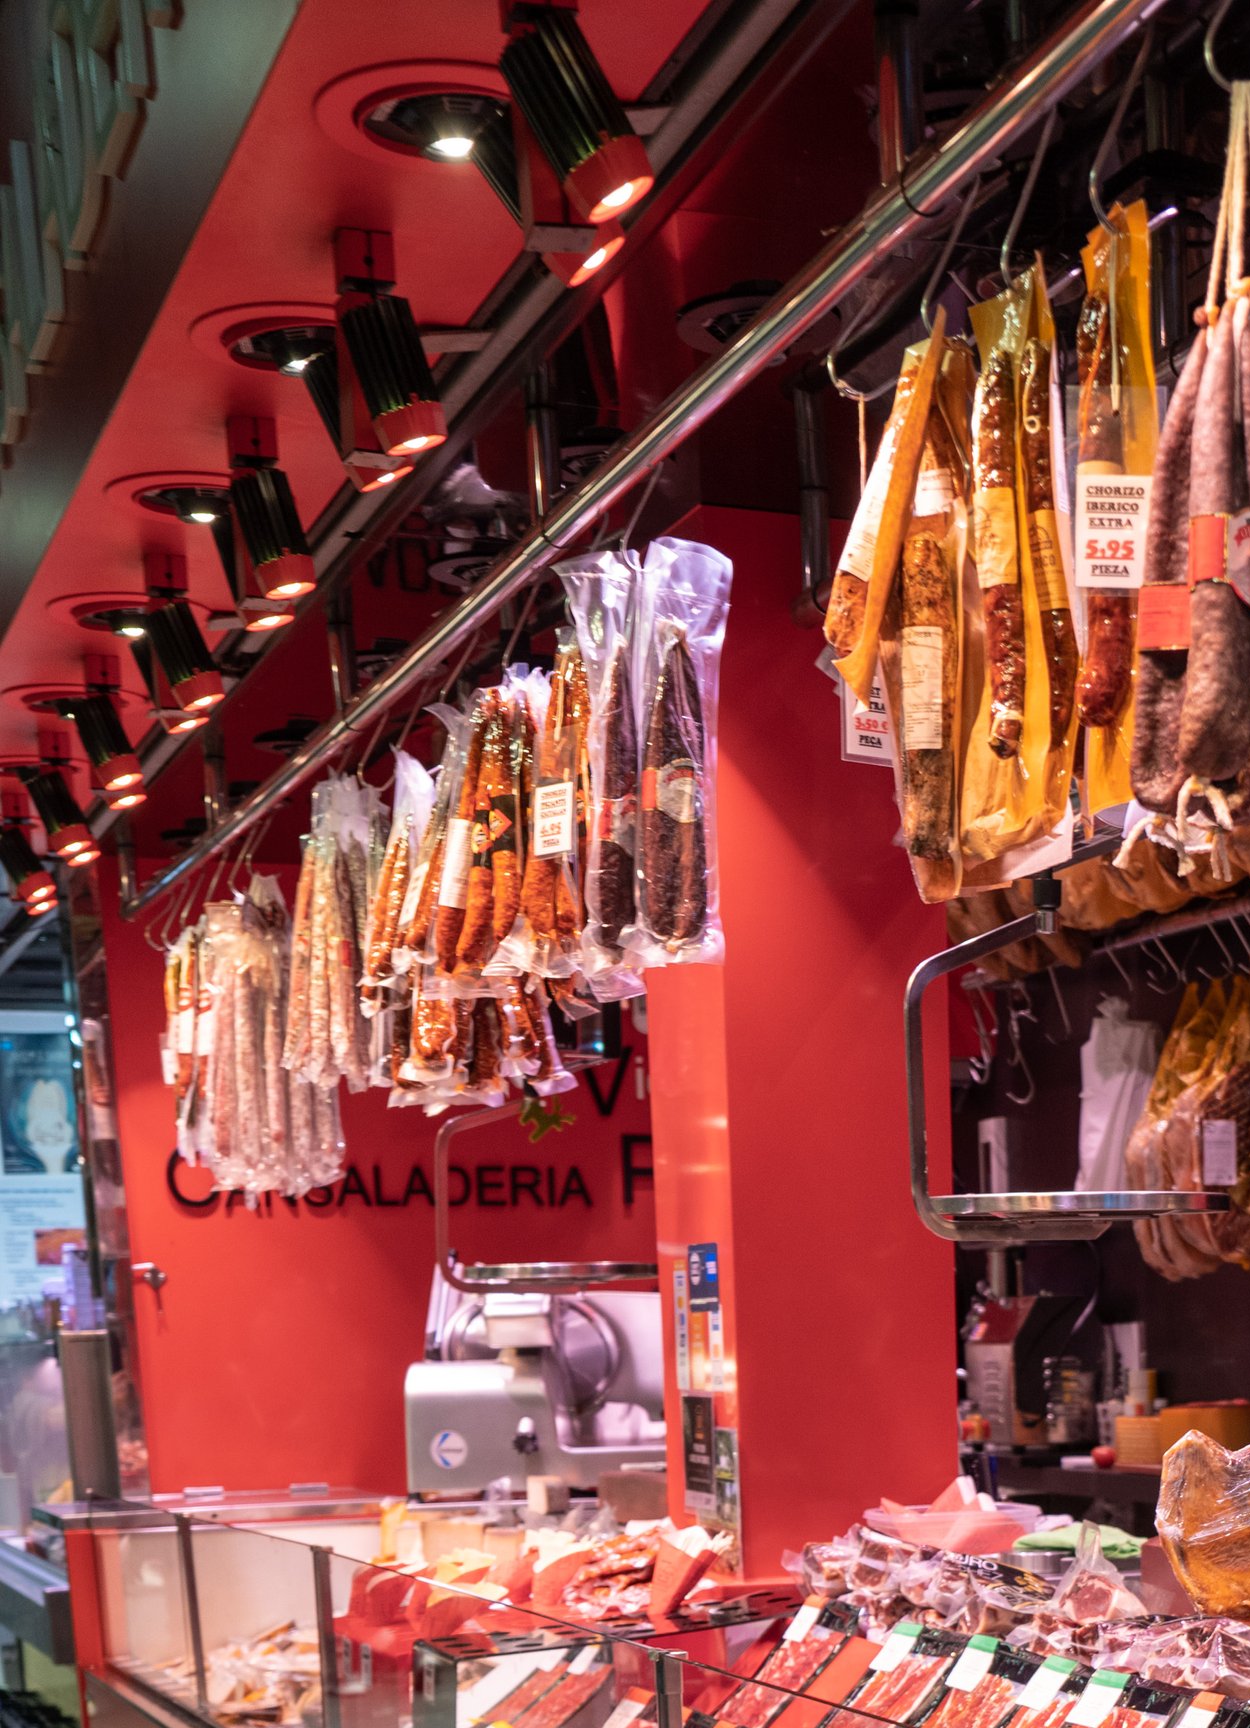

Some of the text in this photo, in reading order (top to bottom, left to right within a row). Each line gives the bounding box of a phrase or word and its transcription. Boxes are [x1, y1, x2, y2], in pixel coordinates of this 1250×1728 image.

[1086, 486, 1145, 496] CHORIZO
[1086, 501, 1139, 512] IBERICO
[1088, 518, 1133, 527] EXTRA
[1091, 564, 1130, 575] PIEZA
